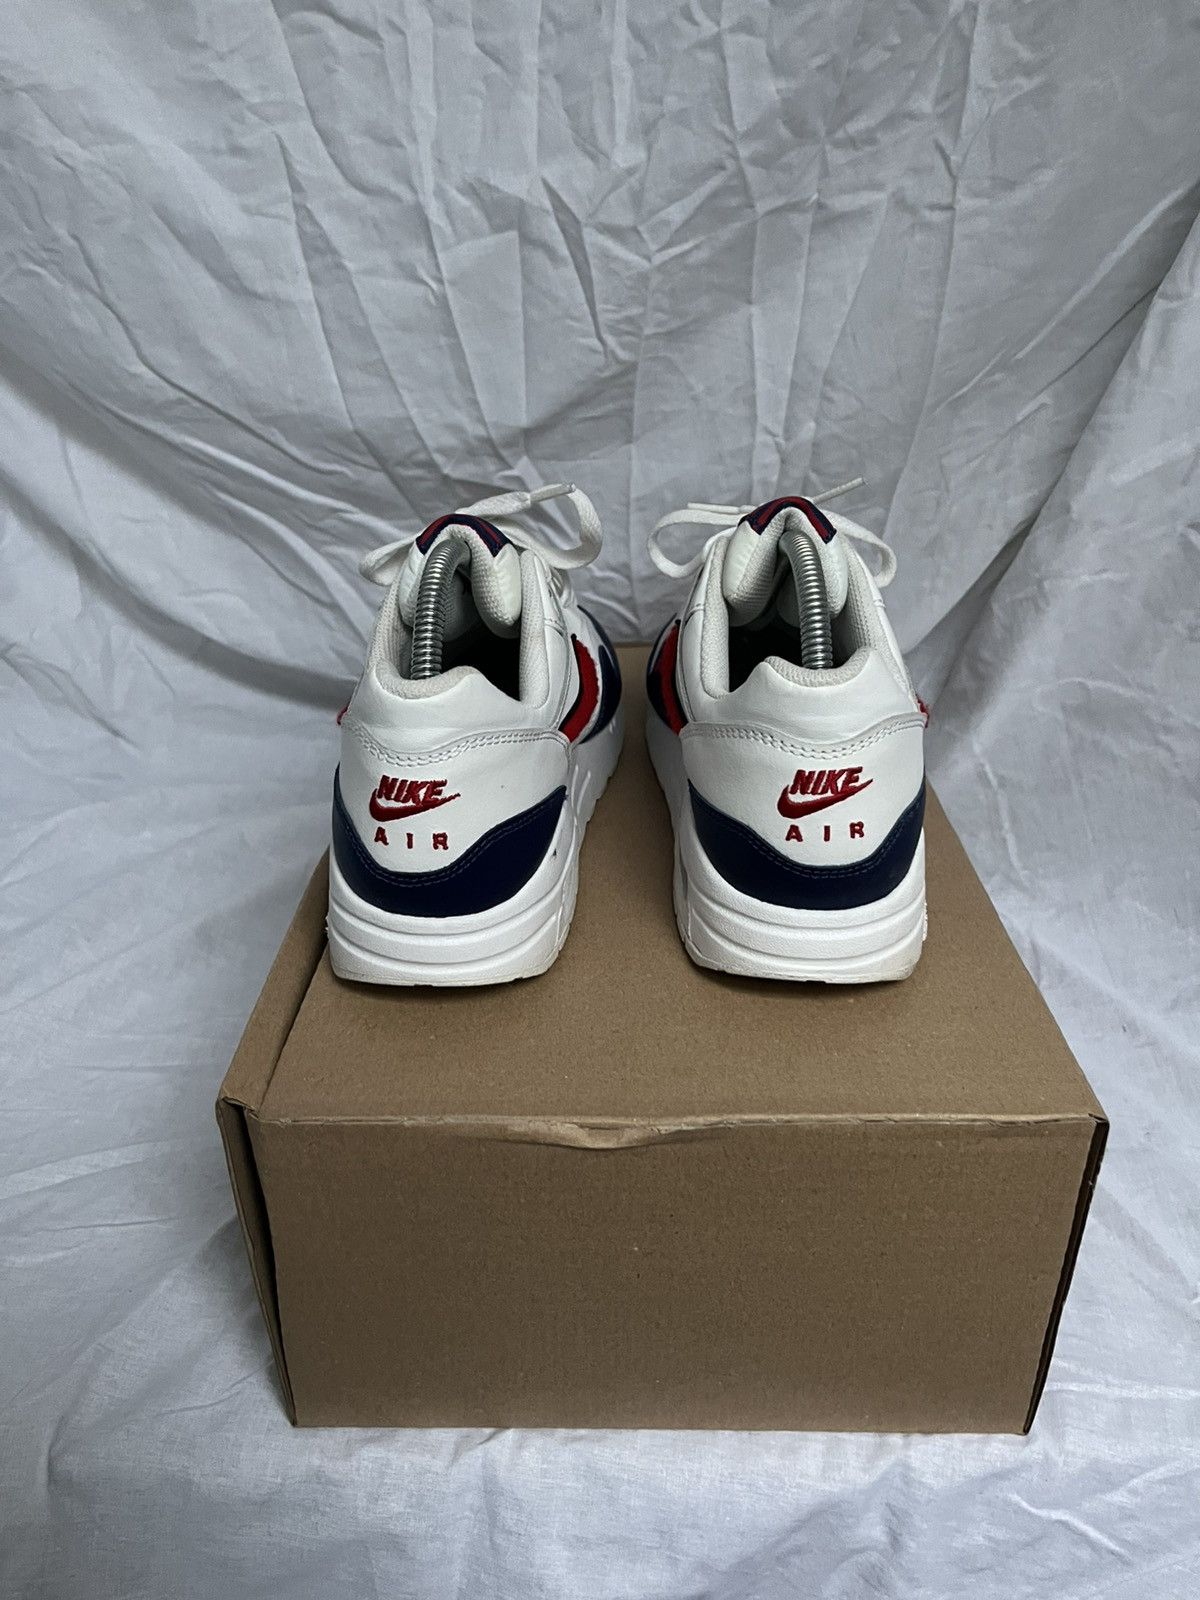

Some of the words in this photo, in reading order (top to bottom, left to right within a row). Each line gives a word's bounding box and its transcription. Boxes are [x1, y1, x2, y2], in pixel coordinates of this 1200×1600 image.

[377, 775, 447, 805] NIKE
[789, 766, 863, 795] NIKE
[374, 826, 449, 850] AIR
[785, 821, 864, 842] AIR
